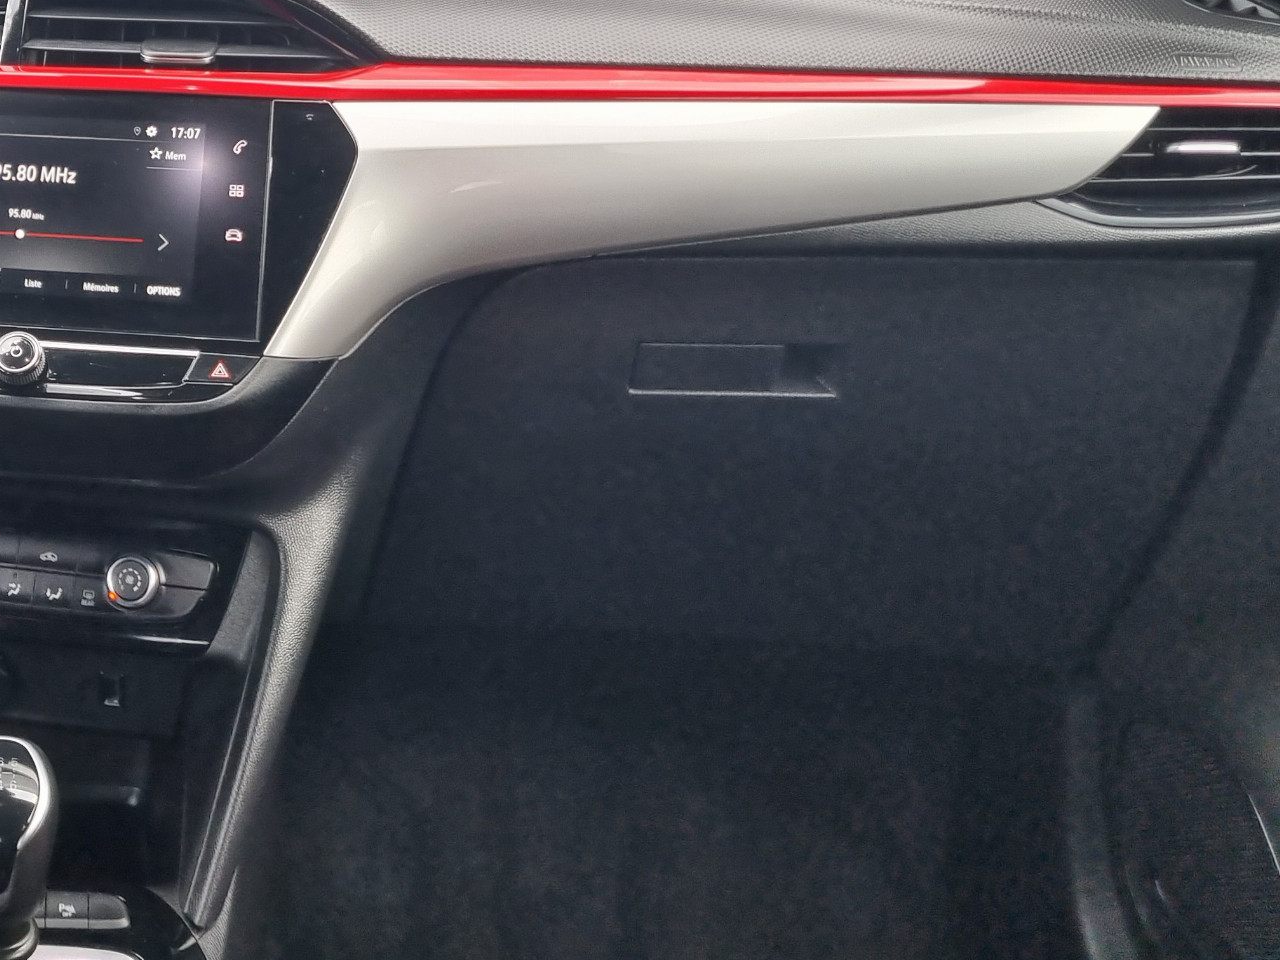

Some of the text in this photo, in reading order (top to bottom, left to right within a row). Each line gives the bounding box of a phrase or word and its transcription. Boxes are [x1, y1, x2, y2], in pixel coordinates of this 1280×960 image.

[170, 125, 201, 140] 17:07
[165, 149, 187, 161] Mem
[39, 165, 77, 185] MHz
[8, 208, 32, 219] 95.80
[24, 277, 42, 288] Liste
[83, 280, 119, 294] Mémoires
[146, 284, 181, 297] OPTIONS
